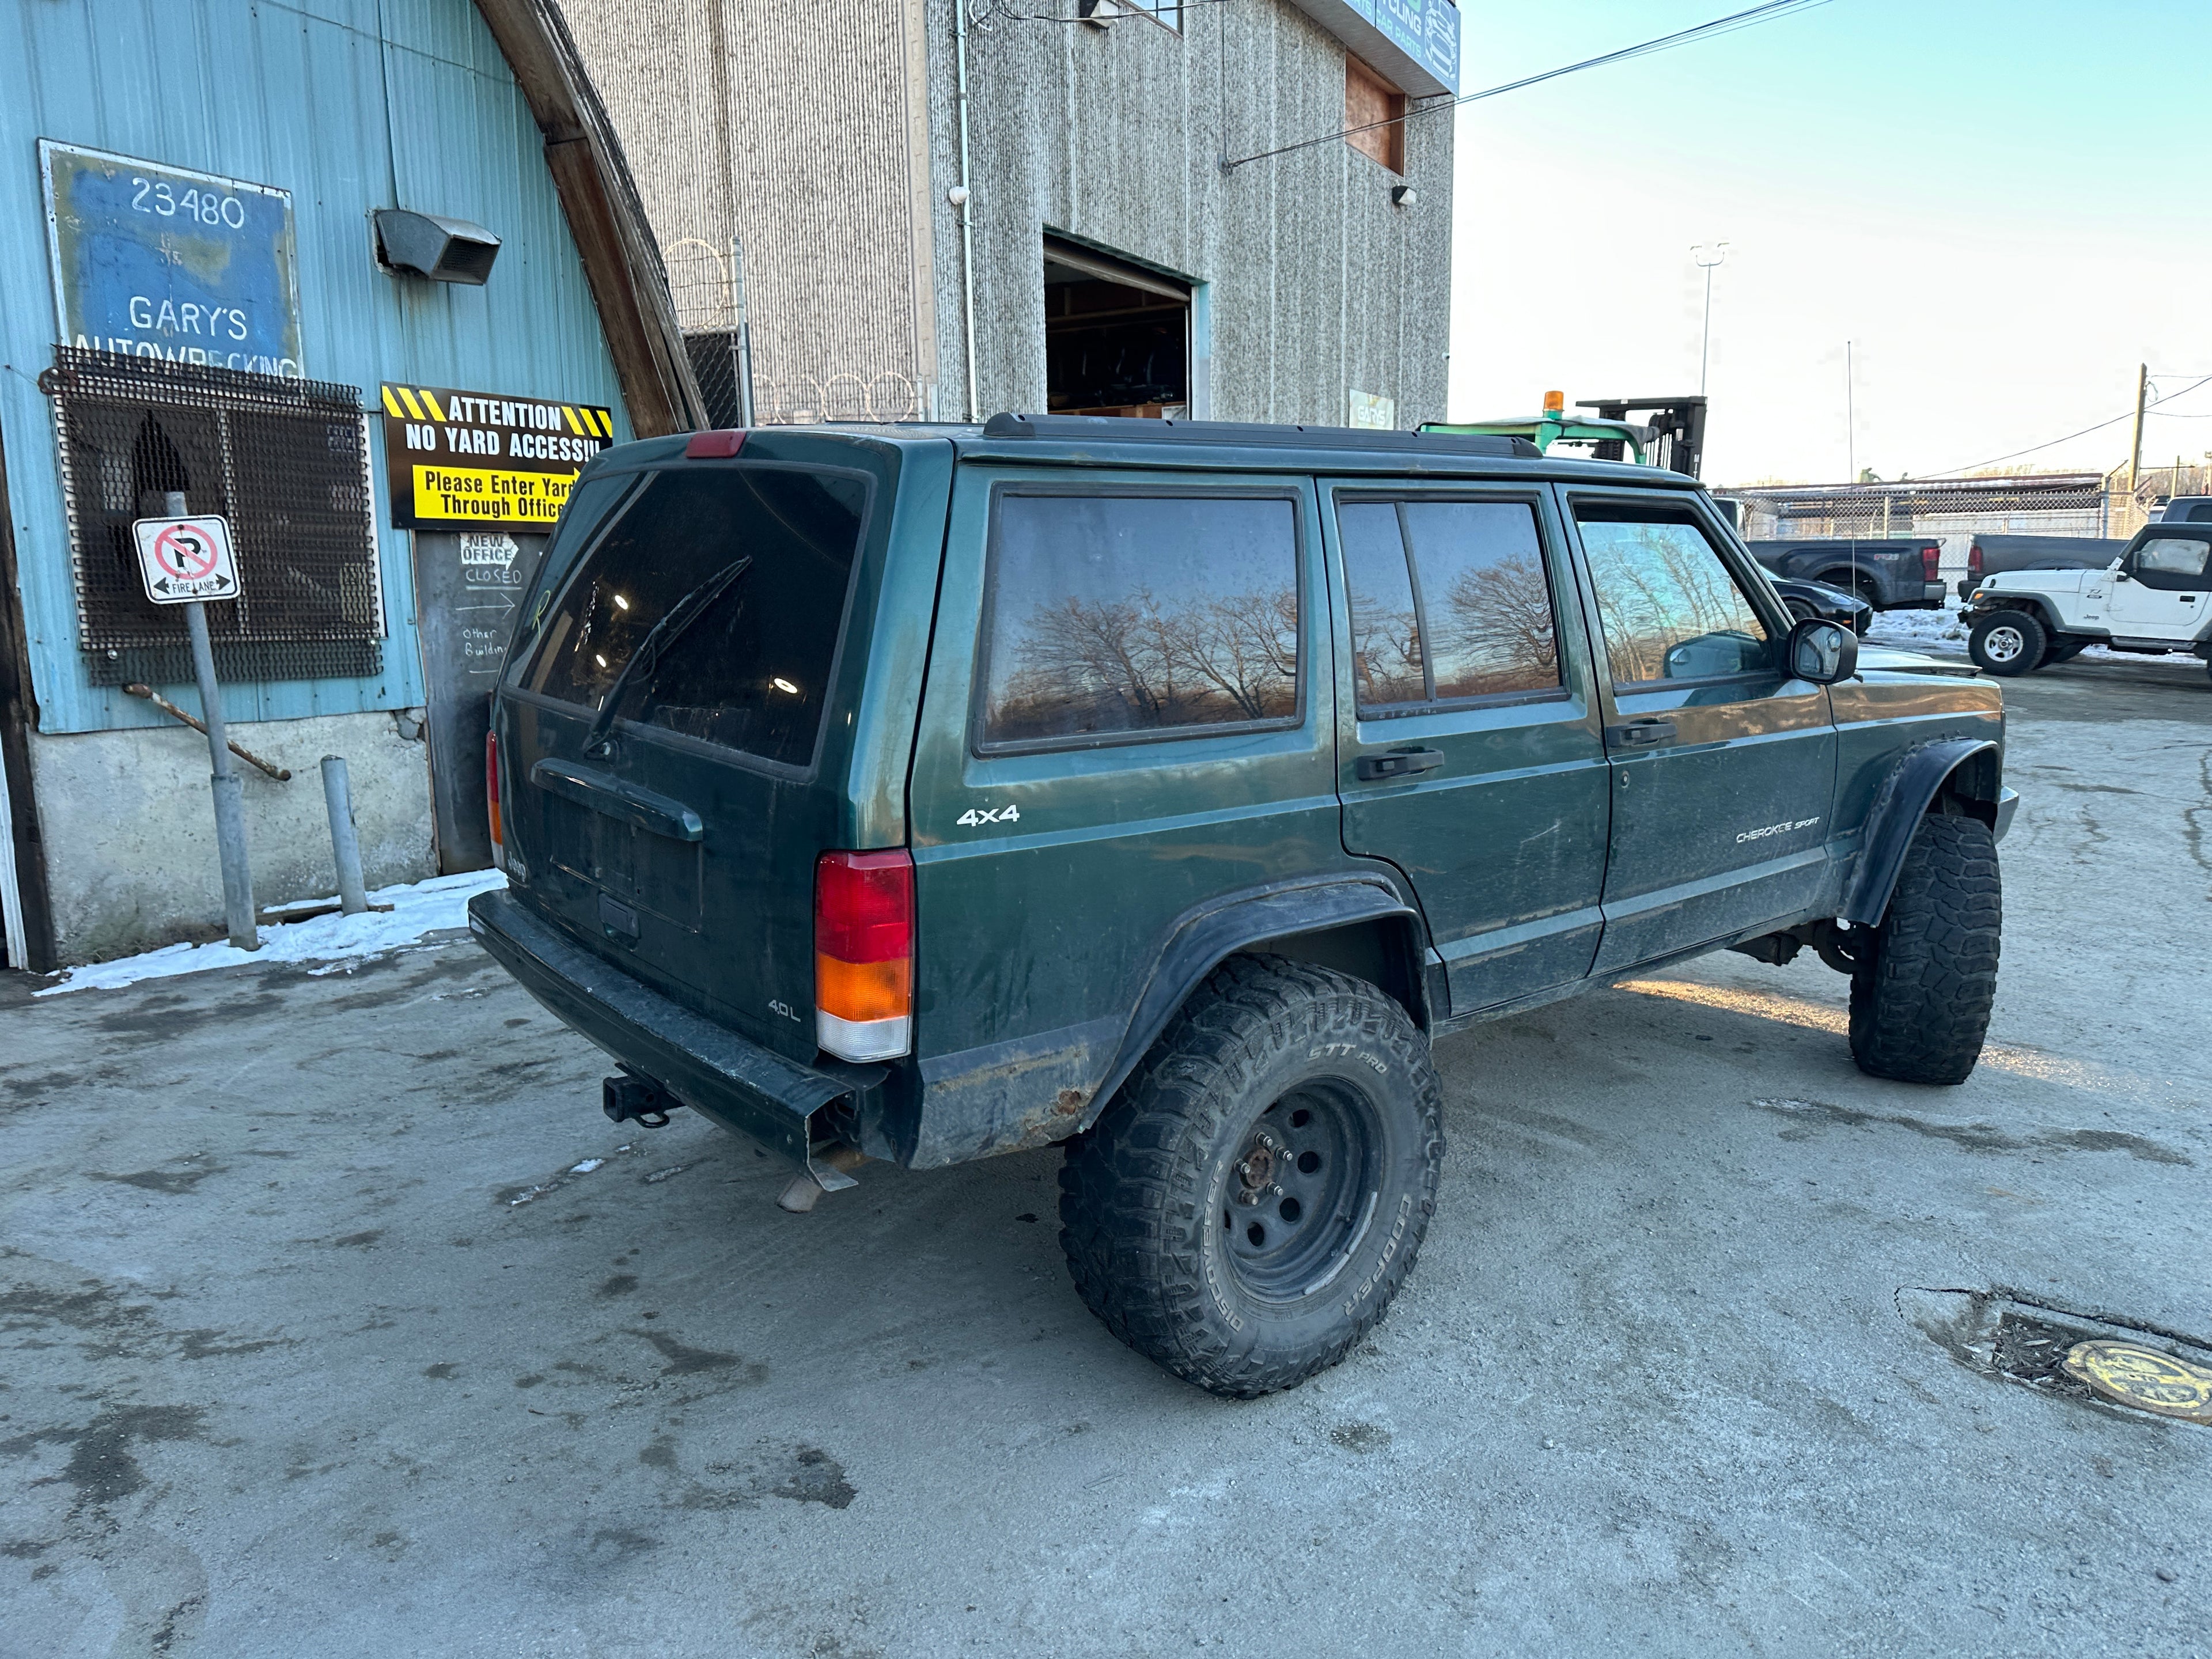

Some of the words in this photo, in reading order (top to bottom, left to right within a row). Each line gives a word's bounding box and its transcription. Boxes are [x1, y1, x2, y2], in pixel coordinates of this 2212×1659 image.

[1383, 0, 1421, 36] CLING
[1376, 8, 1393, 35] CAR
[1395, 25, 1421, 58] PARTS
[131, 177, 245, 229] 23480
[130, 296, 248, 340] GARY'S
[449, 395, 562, 431] ATTENTION
[406, 423, 437, 452] NO
[445, 427, 500, 456] YARD
[425, 471, 483, 494] Please
[491, 475, 535, 496] Enter
[441, 494, 510, 519] Through
[463, 548, 513, 562] OFFICE
[469, 534, 503, 547] NEW
[172, 582, 191, 594] FIRE
[192, 581, 215, 593] LANE
[465, 569, 522, 584] CLOSED
[465, 642, 507, 657] Buildin
[1736, 821, 1793, 843] CHEROKEE
[1794, 816, 1820, 830] SPORT
[1304, 1043, 1357, 1063] STT
[1355, 1051, 1388, 1074] PRO
[1343, 1192, 1412, 1316] COOPER
